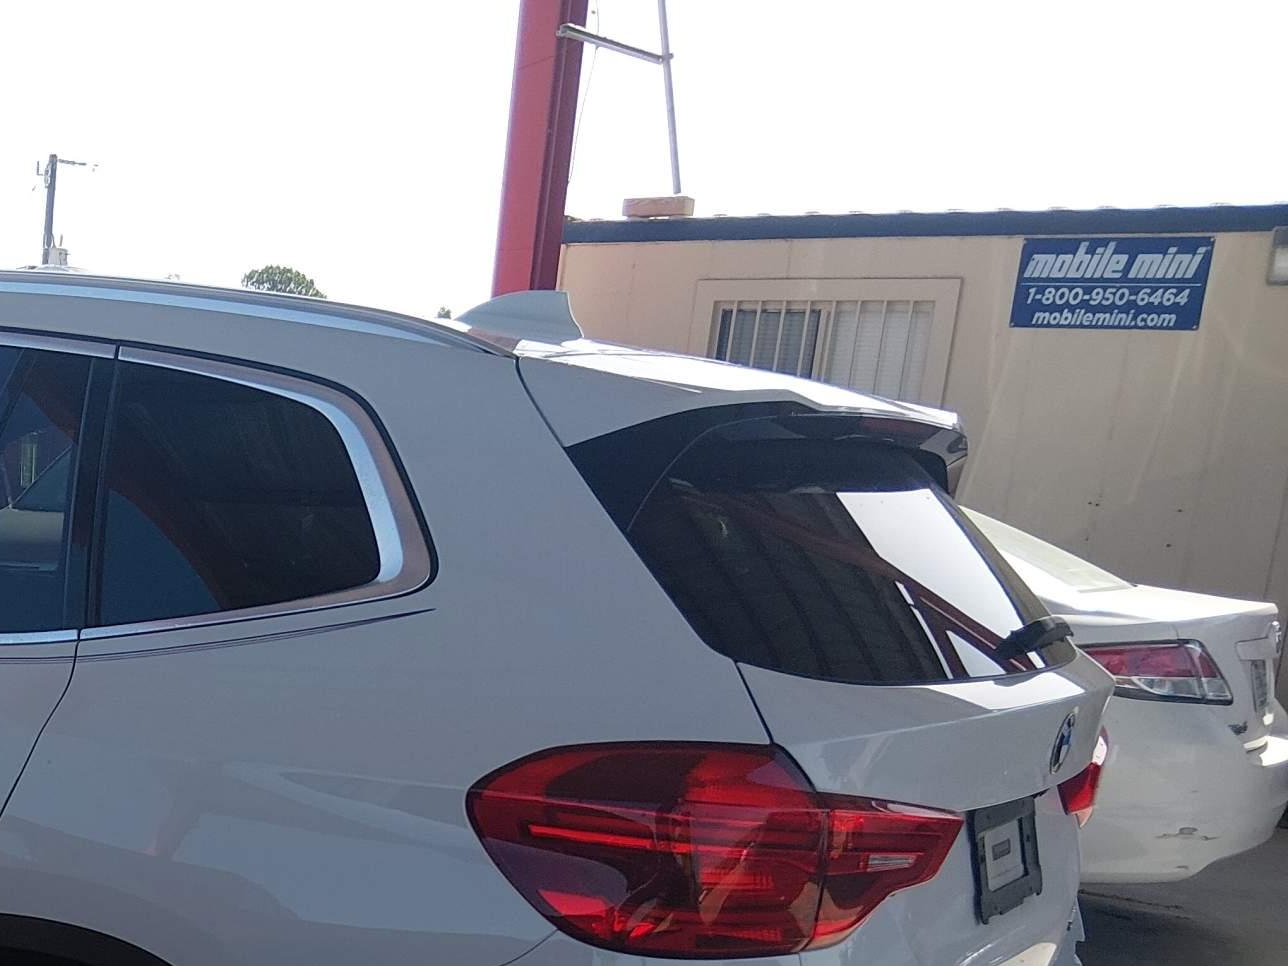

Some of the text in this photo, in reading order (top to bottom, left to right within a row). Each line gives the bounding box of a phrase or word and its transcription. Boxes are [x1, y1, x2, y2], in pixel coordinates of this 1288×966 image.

[1023, 241, 1208, 279] mobile mini
[1026, 287, 1191, 306] 1-800-950-6464
[1031, 308, 1177, 327] mobilemini.com
